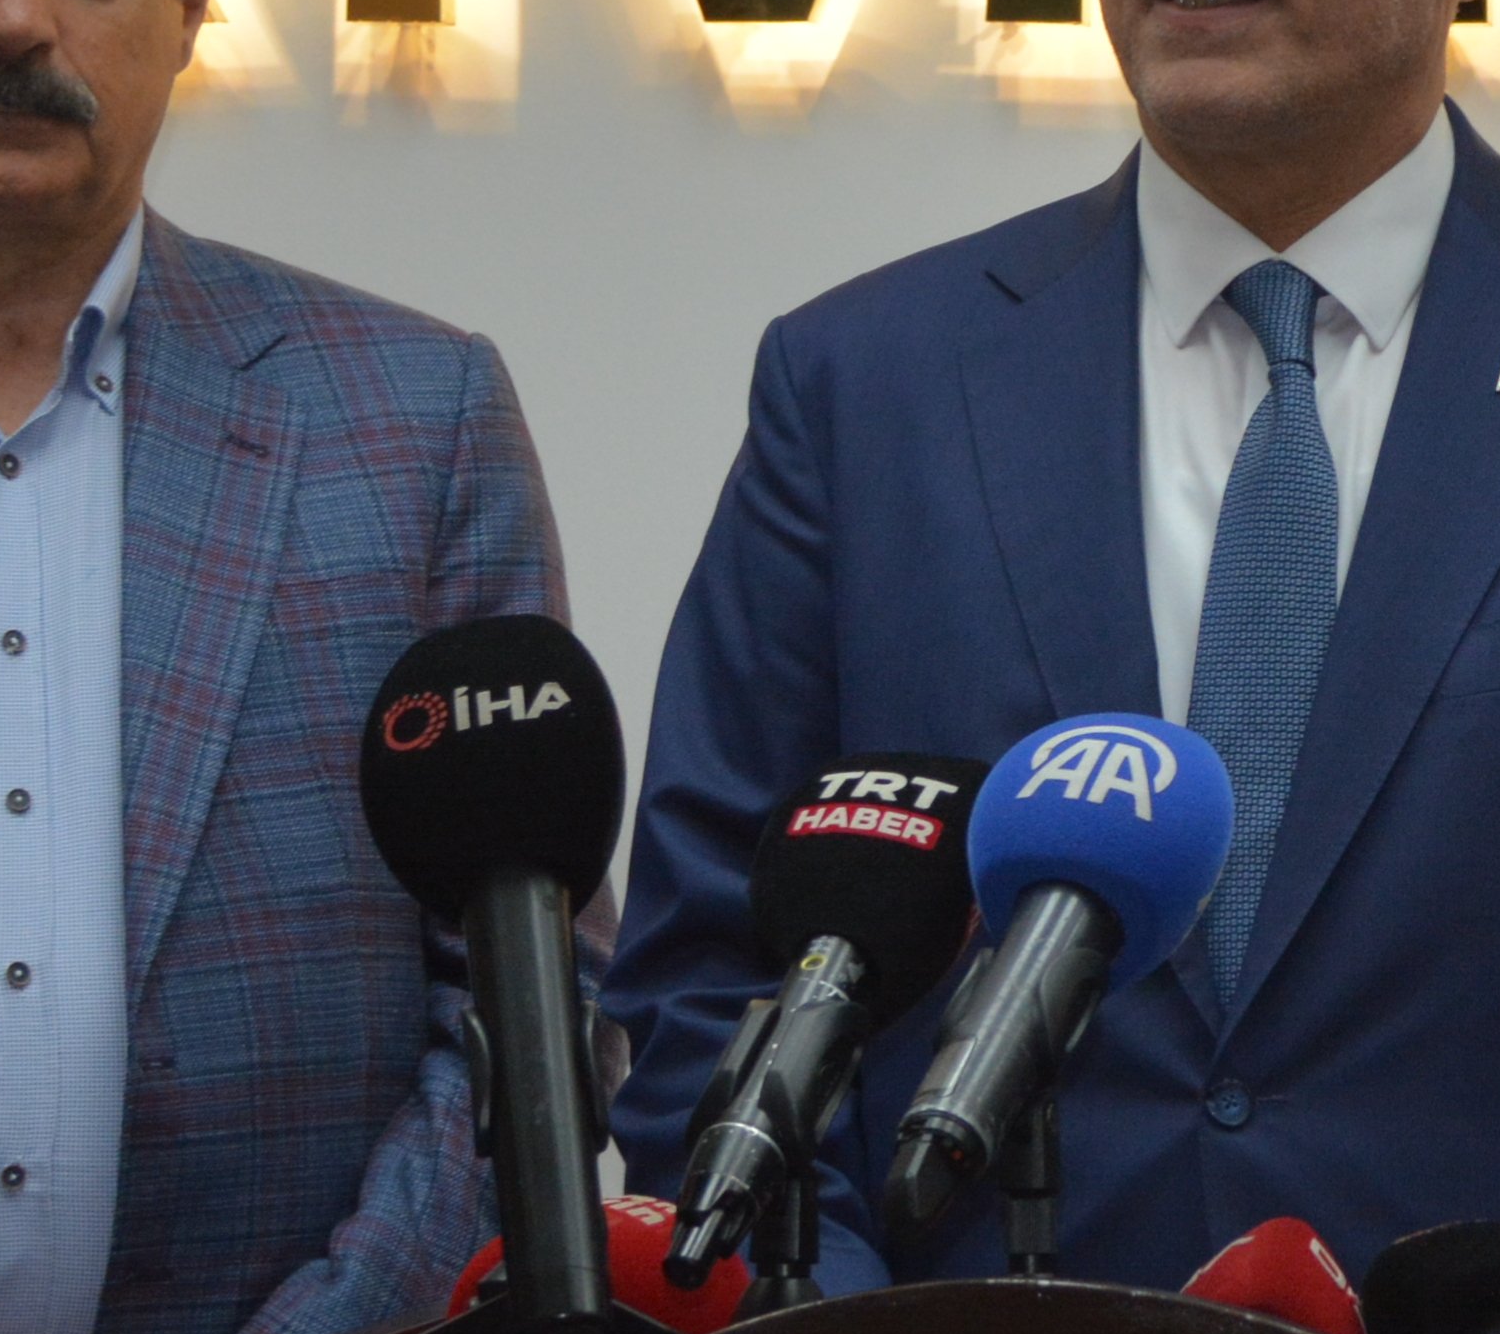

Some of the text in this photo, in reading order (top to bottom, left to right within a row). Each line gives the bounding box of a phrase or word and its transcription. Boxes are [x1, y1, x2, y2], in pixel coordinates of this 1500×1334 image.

[454, 681, 572, 732] İHA
[818, 770, 960, 810] TRT
[1015, 737, 1153, 822] AA
[792, 806, 935, 845] HABER
